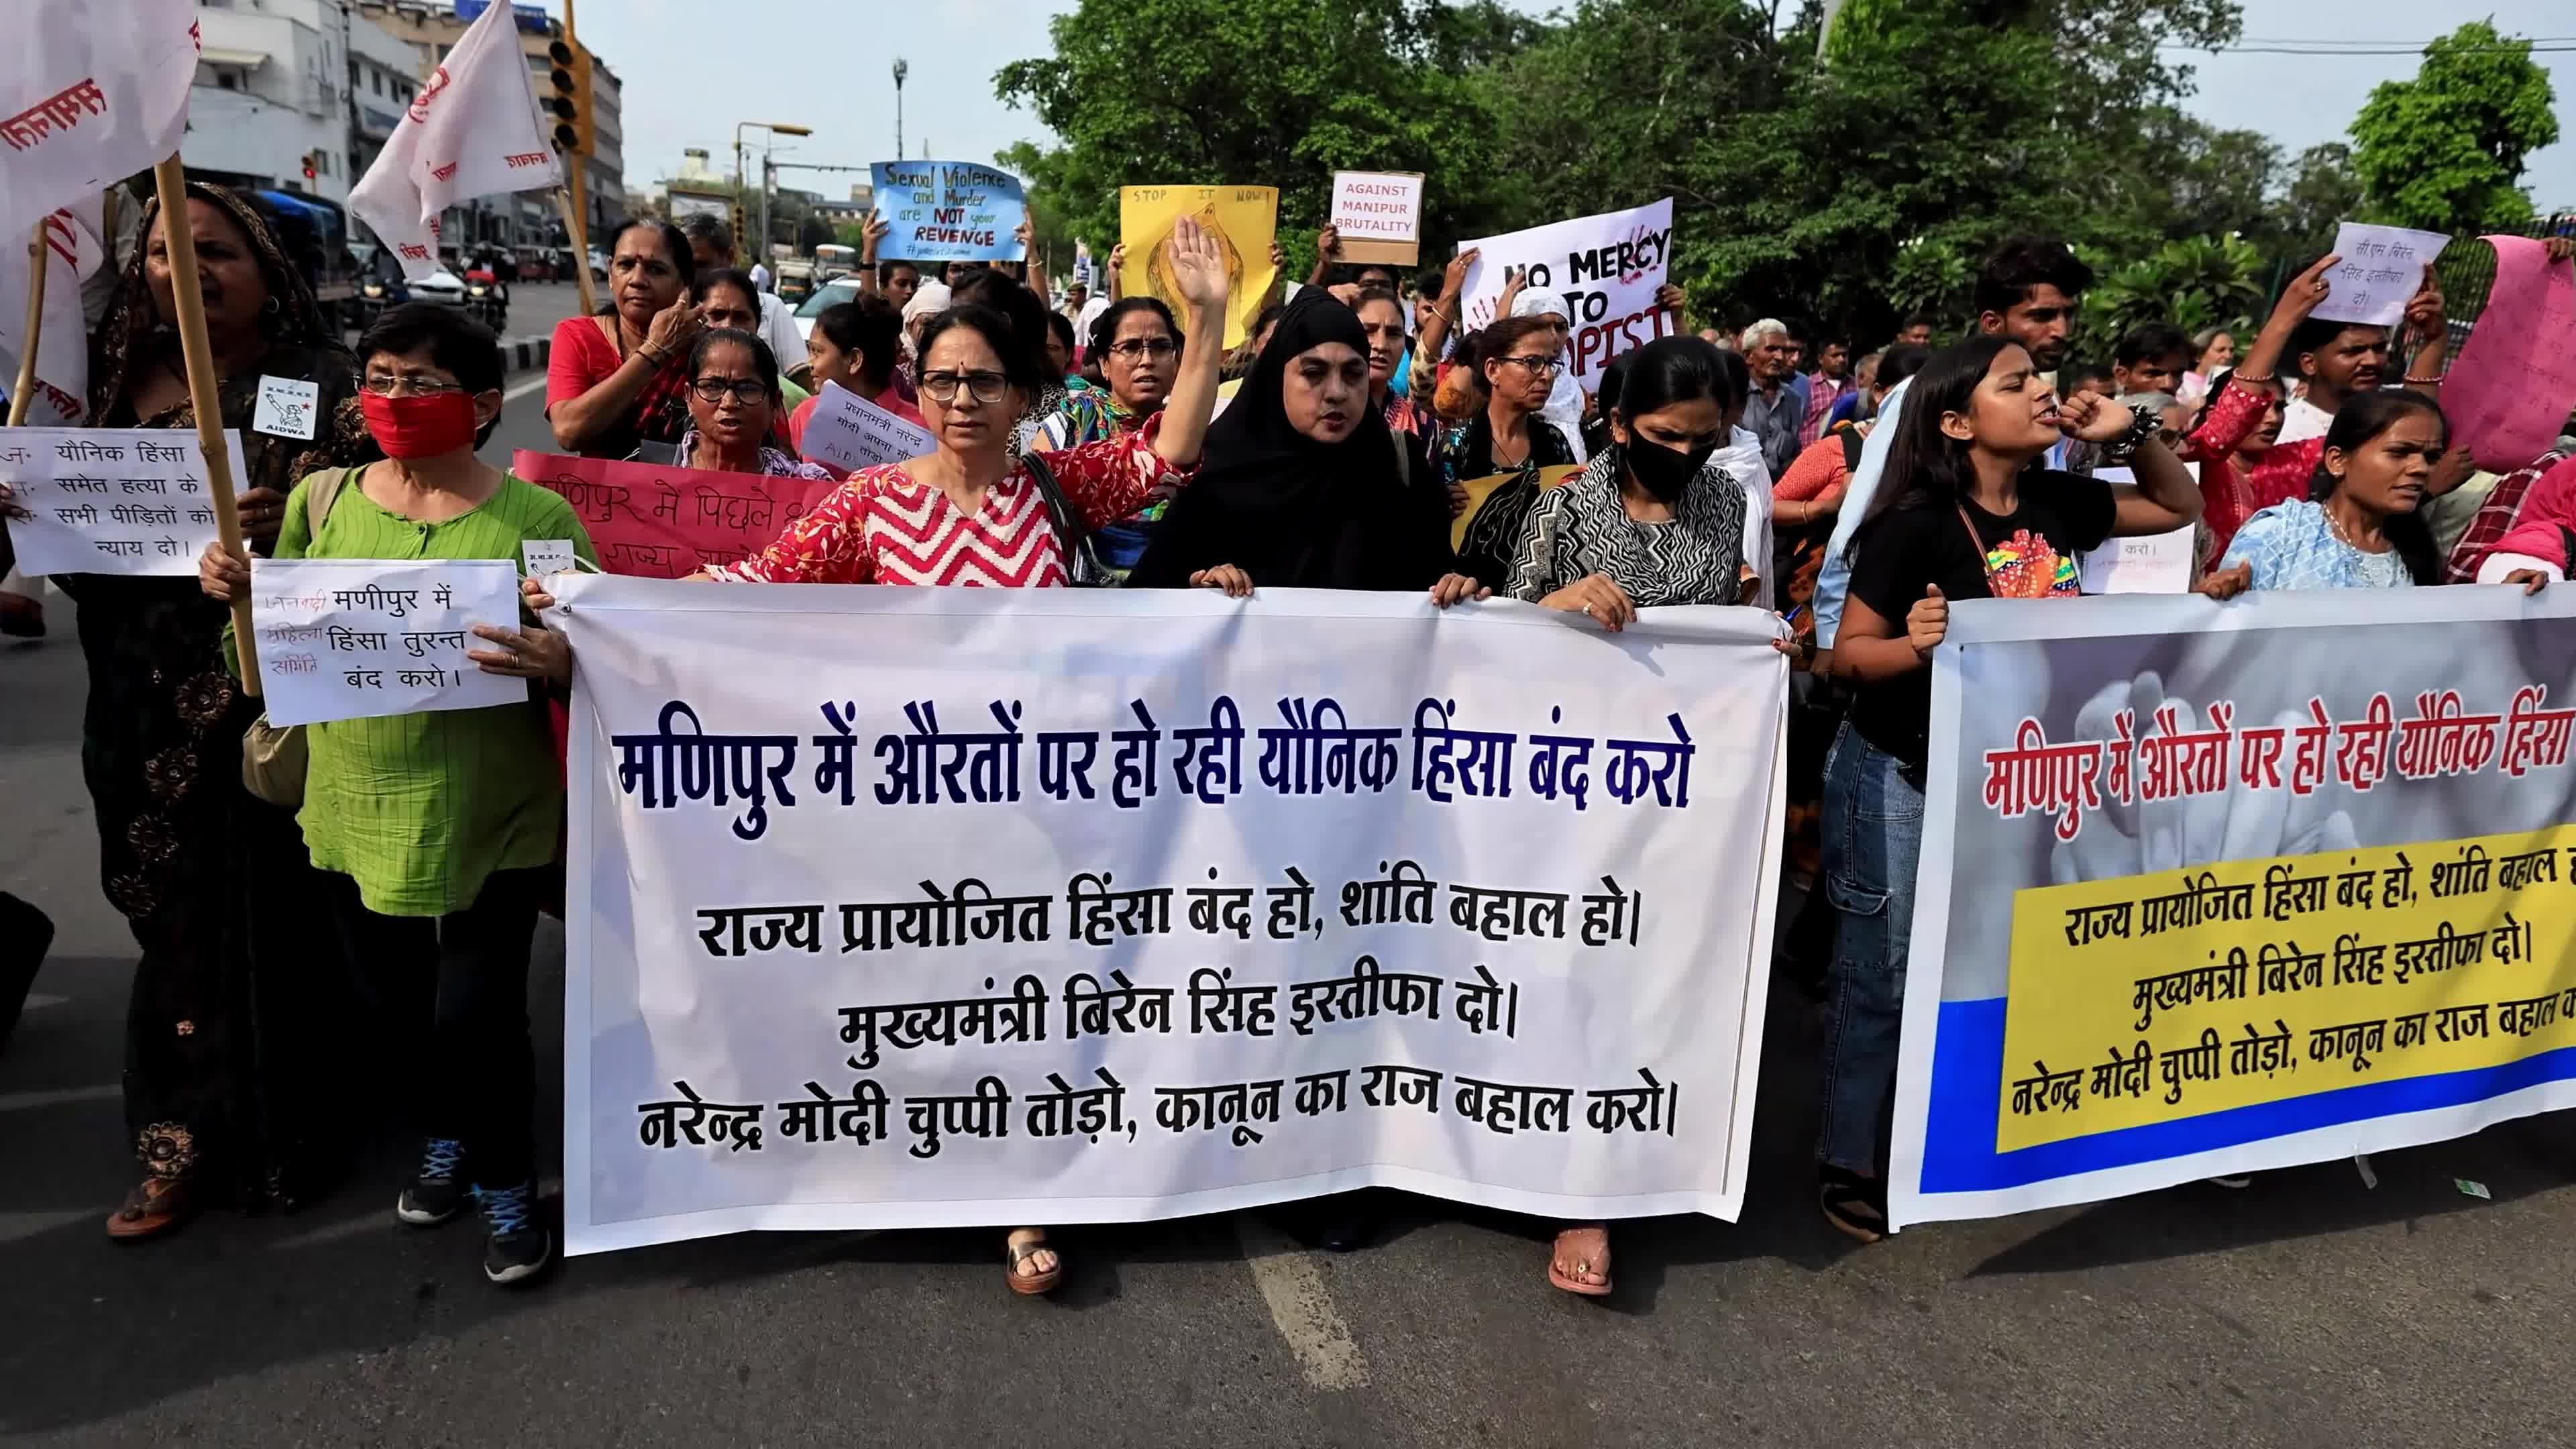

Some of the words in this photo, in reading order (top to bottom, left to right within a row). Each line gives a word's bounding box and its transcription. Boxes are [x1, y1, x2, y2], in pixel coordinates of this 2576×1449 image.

[885, 163, 935, 189] Sexual
[943, 166, 1006, 189] Violence
[1346, 183, 1409, 197] AGAINST
[914, 189, 934, 205] and
[945, 189, 986, 207] Murder
[1134, 189, 1167, 202] STOP
[1197, 189, 1216, 200] IT
[1342, 201, 1407, 215] MANIPUR
[899, 209, 922, 221] are
[934, 207, 965, 224] NOT
[1336, 218, 1412, 231] BRUTALITY
[914, 227, 995, 247] REVENGE
[1569, 227, 1673, 284] MERCY
[1561, 290, 1609, 328] TO
[1566, 306, 1675, 377] PIST
[266, 425, 305, 435] AIDWA
[837, 415, 861, 435] मोदी
[864, 431, 894, 453] अपना
[54, 440, 124, 462] यौनिक
[136, 441, 186, 463] हिंसा
[54, 473, 108, 494] समेत
[118, 479, 166, 494] हत्या
[177, 473, 198, 494] के
[54, 504, 98, 524] सभी
[109, 504, 178, 527] पीड़ितों
[188, 506, 215, 525] को
[695, 485, 777, 535] पिछले
[94, 541, 145, 556] न्याय
[333, 584, 419, 618] मणीपुर
[432, 583, 453, 610] में
[327, 625, 387, 651] हिंसा
[400, 631, 467, 657] तुरन्त
[343, 665, 383, 689] बंद
[611, 700, 798, 841] मणिपुर
[813, 700, 858, 806] में
[873, 700, 1023, 804] औरतों
[1037, 731, 1099, 800] पर
[1111, 699, 1161, 808] हो
[1173, 695, 1244, 804] रही
[1258, 696, 1401, 796] यौनिक
[1411, 697, 1517, 803] हिंसा
[1529, 705, 1594, 810] बंद
[1606, 712, 1696, 808] करो
[1986, 720, 2100, 839] मणिपुर
[2110, 706, 2133, 803] में
[2141, 702, 2231, 799] औरतों
[2241, 729, 2284, 789] पर
[2292, 700, 2330, 793] हो
[2337, 694, 2392, 789] रही
[2398, 691, 2502, 776] यौनिक
[2500, 686, 2576, 776] हिंसा
[697, 905, 824, 957] राज्य
[839, 878, 1053, 953] प्रायोजित
[1067, 872, 1173, 946] हिंसा
[1187, 867, 1253, 939] बंद
[1267, 866, 1323, 941] हो,
[1340, 860, 1436, 927] शांति
[1449, 883, 1568, 941] बहाल
[1580, 875, 1642, 947] हो।
[2065, 900, 2133, 945] राज्य
[2141, 871, 2254, 936] प्रायोजित
[2263, 865, 2328, 920] हिंसा
[2336, 858, 2372, 910] बंद
[2383, 851, 2418, 908] हो,
[2430, 845, 2493, 898] शांति
[2499, 848, 2557, 892] बहाल
[2133, 946, 2249, 1031] मुख्यमंत्री
[2257, 940, 2324, 996] बिरेन
[2332, 932, 2385, 986] सिंह
[2394, 921, 2486, 984] इस्तीफा
[2492, 912, 2531, 965] दो।
[838, 974, 1049, 1069] मुख्यमंत्री
[1063, 969, 1174, 1040] बिरेन
[1188, 967, 1277, 1036] सिंह
[1290, 955, 1443, 1035] इस्तीफा
[1455, 965, 1519, 1039] दो।
[2012, 1061, 2082, 1116] नरेन्द्र
[2090, 1040, 2151, 1099] मोदी
[2160, 1028, 2221, 1105] चुप्पी
[2231, 1020, 2297, 1081] तोड़ो,
[2309, 1017, 2385, 1073] कानून
[2394, 1012, 2429, 1049] का
[2435, 1004, 2489, 1042] राज
[2497, 993, 2561, 1037] बहाल
[638, 1081, 764, 1152] नरेन्द्र
[778, 1079, 890, 1146] मोदी
[905, 1076, 1011, 1159] चुप्पी
[1026, 1067, 1137, 1144] तोड़ो,
[1155, 1079, 1283, 1147] कानून
[1295, 1069, 1350, 1116] का
[1361, 1065, 1442, 1112] राज
[1455, 1076, 1573, 1134] बहाल
[1587, 1068, 1678, 1137] करो।
